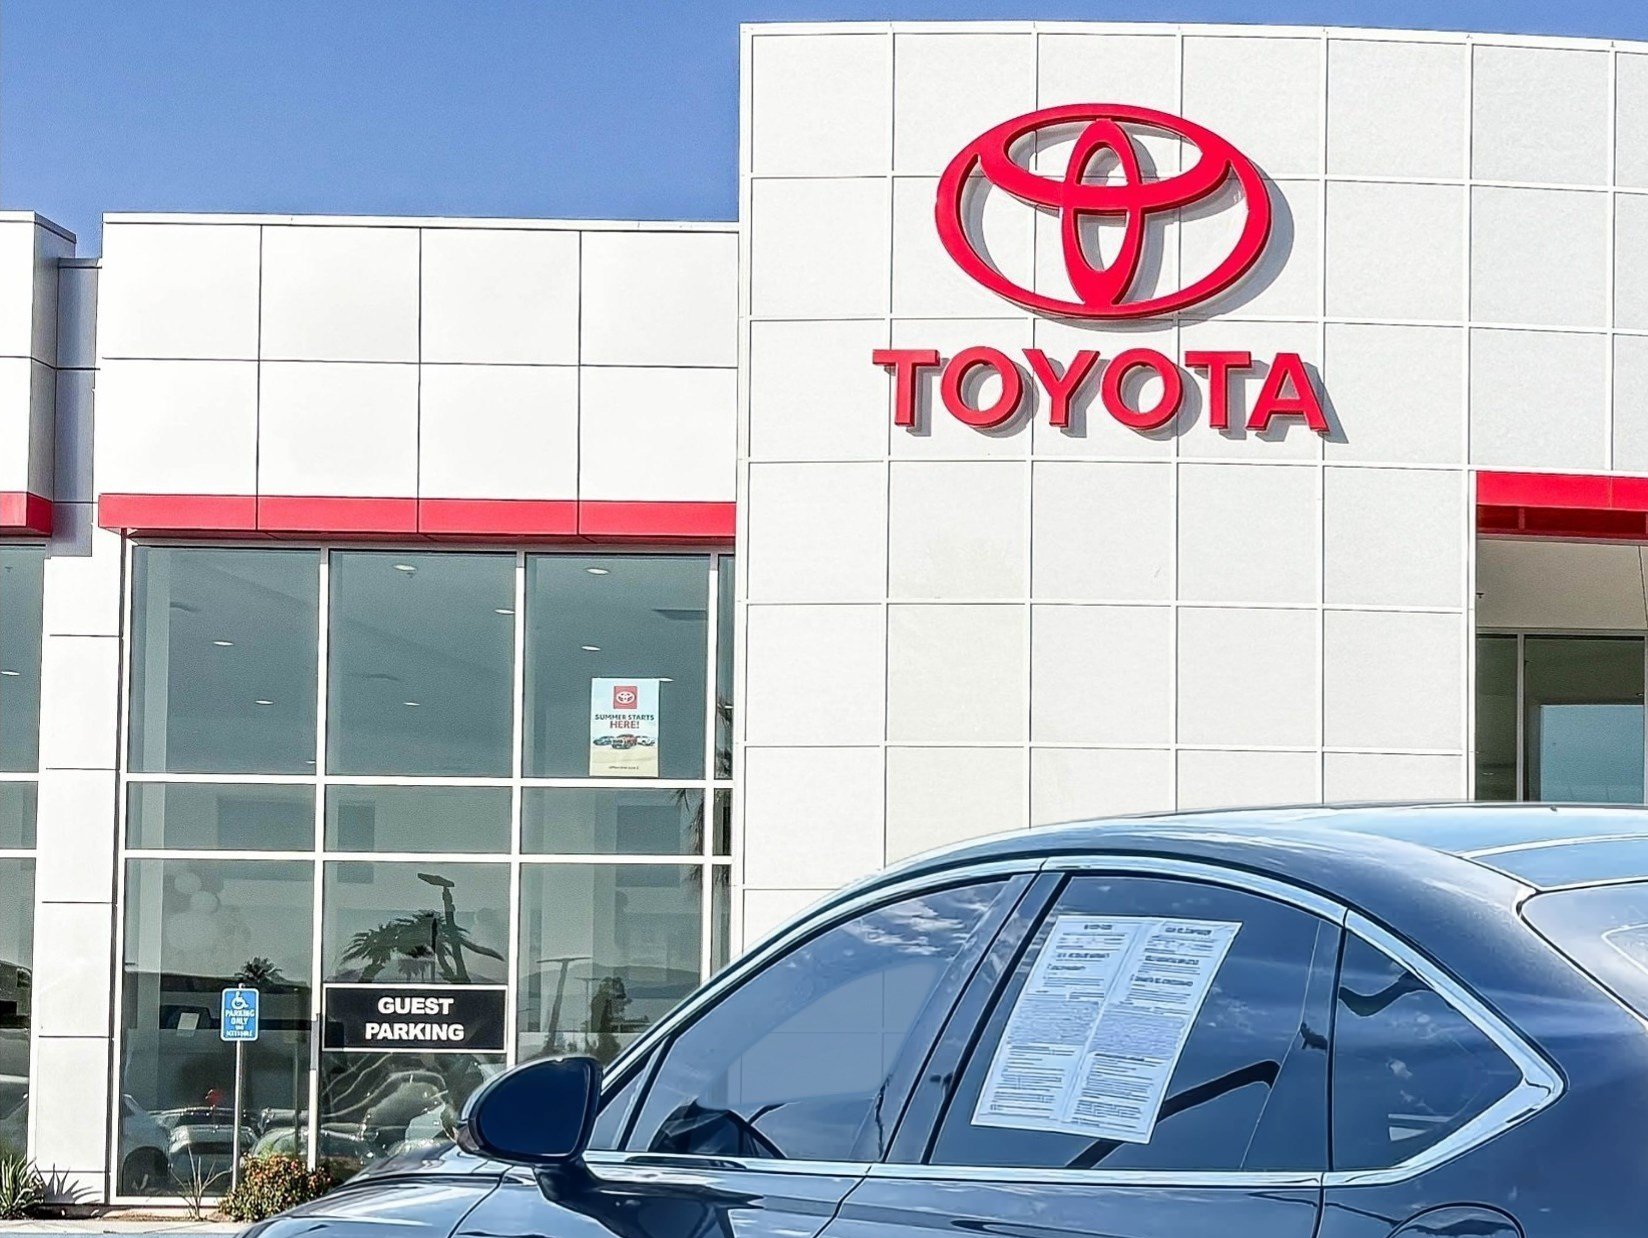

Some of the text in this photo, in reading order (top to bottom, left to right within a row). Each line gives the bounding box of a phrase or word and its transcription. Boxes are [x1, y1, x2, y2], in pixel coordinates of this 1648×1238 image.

[873, 346, 1330, 432] TOYOTA
[609, 720, 640, 729] HERE!
[225, 1009, 255, 1018] PARKING
[377, 997, 455, 1015] GUEST
[364, 1022, 465, 1042] PARKING
